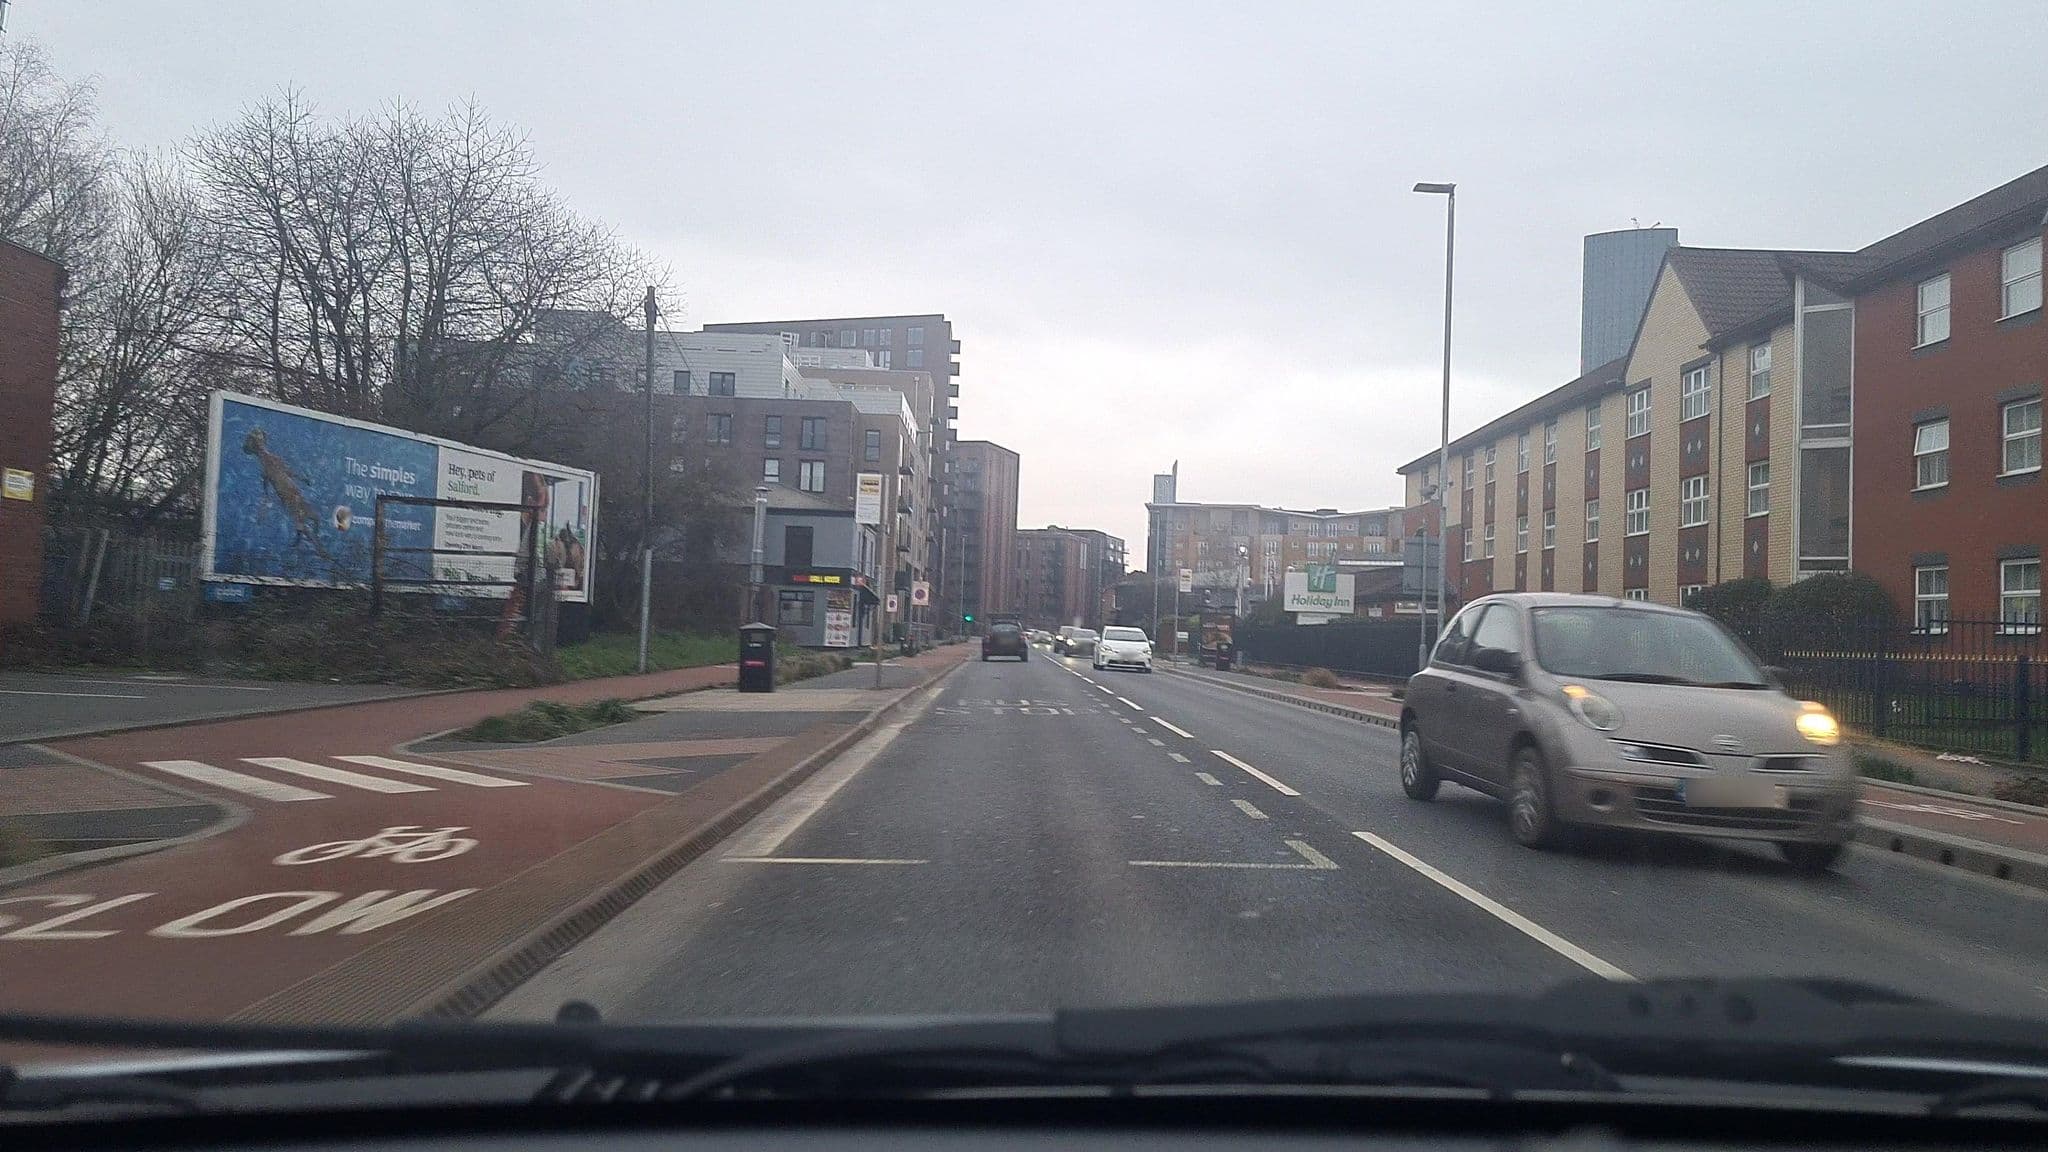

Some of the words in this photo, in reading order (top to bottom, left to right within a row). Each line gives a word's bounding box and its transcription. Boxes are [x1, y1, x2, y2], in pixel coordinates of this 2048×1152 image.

[344, 457, 368, 477] The
[369, 462, 416, 486] simples
[448, 464, 467, 479] Hey,
[469, 469, 486, 482] pets
[487, 471, 496, 482] of
[344, 483, 371, 504] way
[1291, 594, 1333, 609] Holiday
[1334, 596, 1350, 607] Inn
